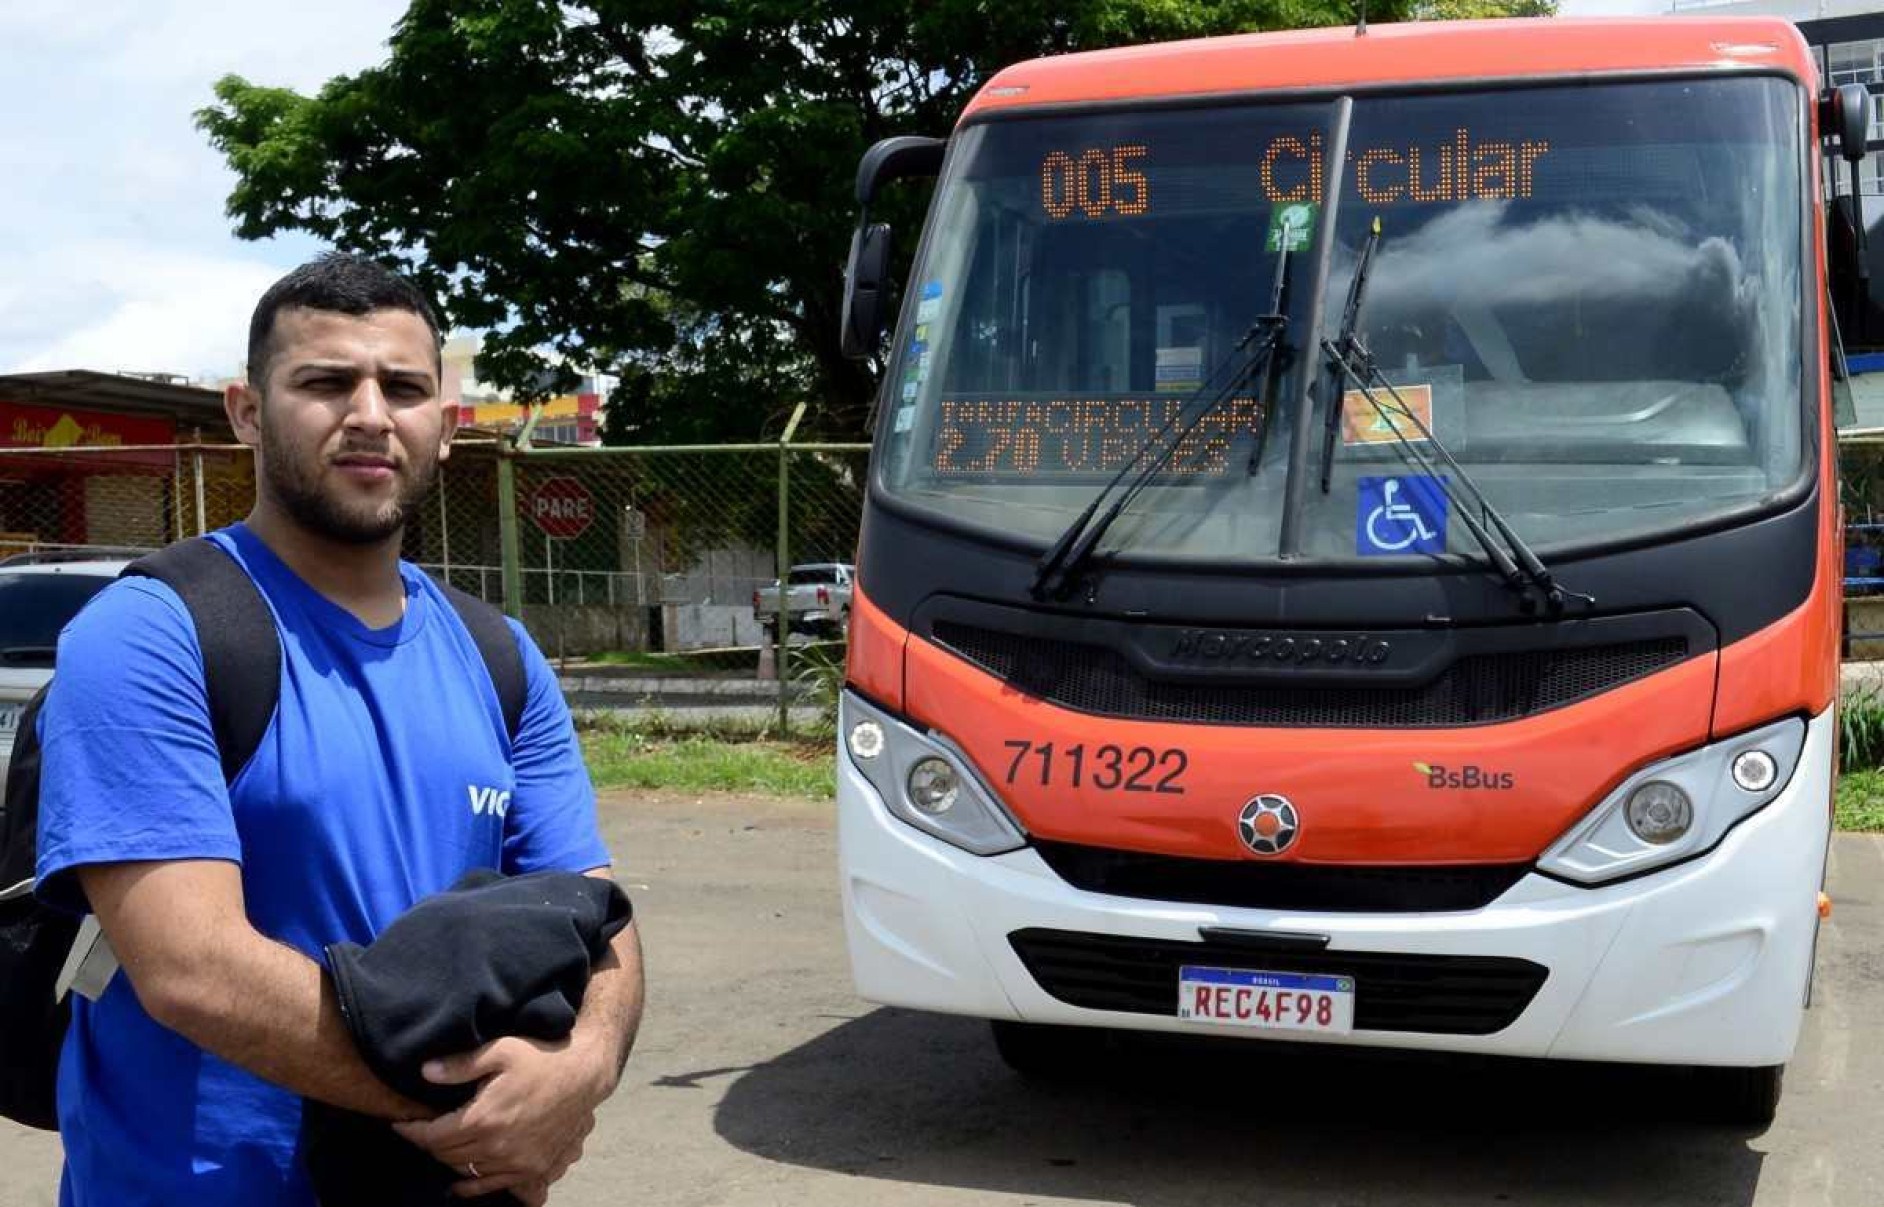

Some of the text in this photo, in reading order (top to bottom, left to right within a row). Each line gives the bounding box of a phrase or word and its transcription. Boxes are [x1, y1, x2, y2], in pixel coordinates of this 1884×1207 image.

[1042, 127, 1550, 218] 005 Cicular
[536, 497, 588, 519] PARE
[1169, 628, 1390, 666] Marcopolo
[1004, 740, 1188, 794] 711322
[1429, 764, 1513, 789] BsBus
[1194, 985, 1333, 1026] REC4F98
